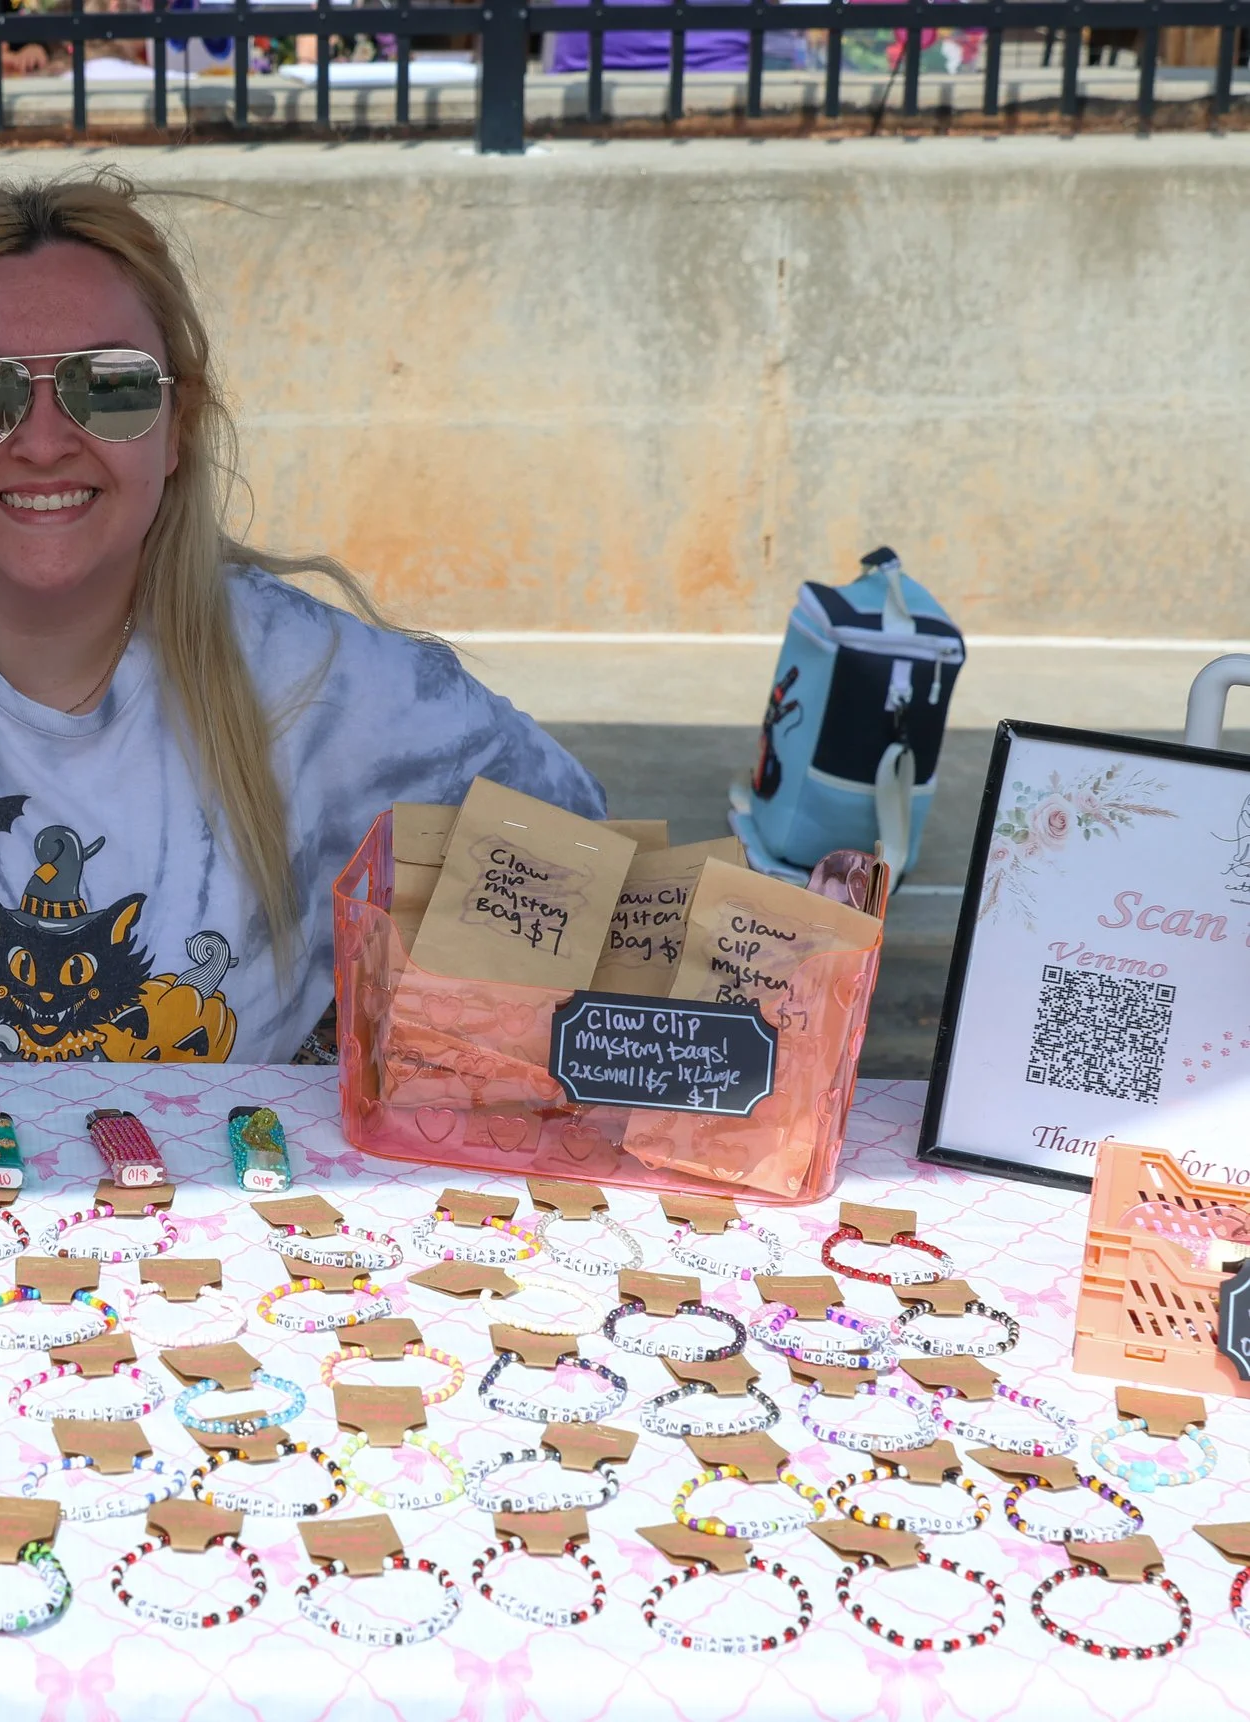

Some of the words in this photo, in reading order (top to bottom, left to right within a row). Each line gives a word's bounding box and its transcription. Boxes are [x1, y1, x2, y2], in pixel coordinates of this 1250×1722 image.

[490, 848, 549, 882] Claw
[485, 869, 526, 886] Clip
[618, 892, 652, 905] aw
[659, 888, 689, 905] Cli
[1098, 890, 1227, 942] Scan
[476, 897, 521, 933] Bag
[524, 918, 563, 957] $7
[732, 916, 797, 943] Claw
[611, 930, 652, 961] Bag
[718, 936, 761, 961] Clip
[1048, 941, 1168, 978] Venmo
[587, 1009, 643, 1031] Claw
[652, 1010, 701, 1040] Clip
[687, 1087, 718, 1111] $7
[1033, 1126, 1113, 1158] Than
[1178, 1149, 1216, 1179] for
[1222, 1166, 1250, 1186] yo
[70, 1247, 110, 1259] GIRL
[302, 1249, 345, 1267] SHOW
[354, 1253, 385, 1268] BIZ
[455, 1247, 516, 1263] SEASON
[671, 1247, 739, 1278] CONDUIT
[894, 1272, 932, 1285] TEAM
[276, 1313, 302, 1329] NOT
[317, 1314, 347, 1330] NOW
[614, 1335, 706, 1361] DRACARYS
[825, 1339, 842, 1349] IT
[933, 1340, 995, 1355] EDWARD
[803, 1352, 857, 1368] MONGO
[123, 1404, 142, 1417] WE
[551, 1406, 570, 1422] TO
[694, 1415, 766, 1436] DREAMER
[838, 1431, 870, 1449] BEG
[955, 1421, 1032, 1455] WORKING
[516, 1492, 594, 1512] DELIGHT
[908, 1514, 974, 1532] SPOOKY
